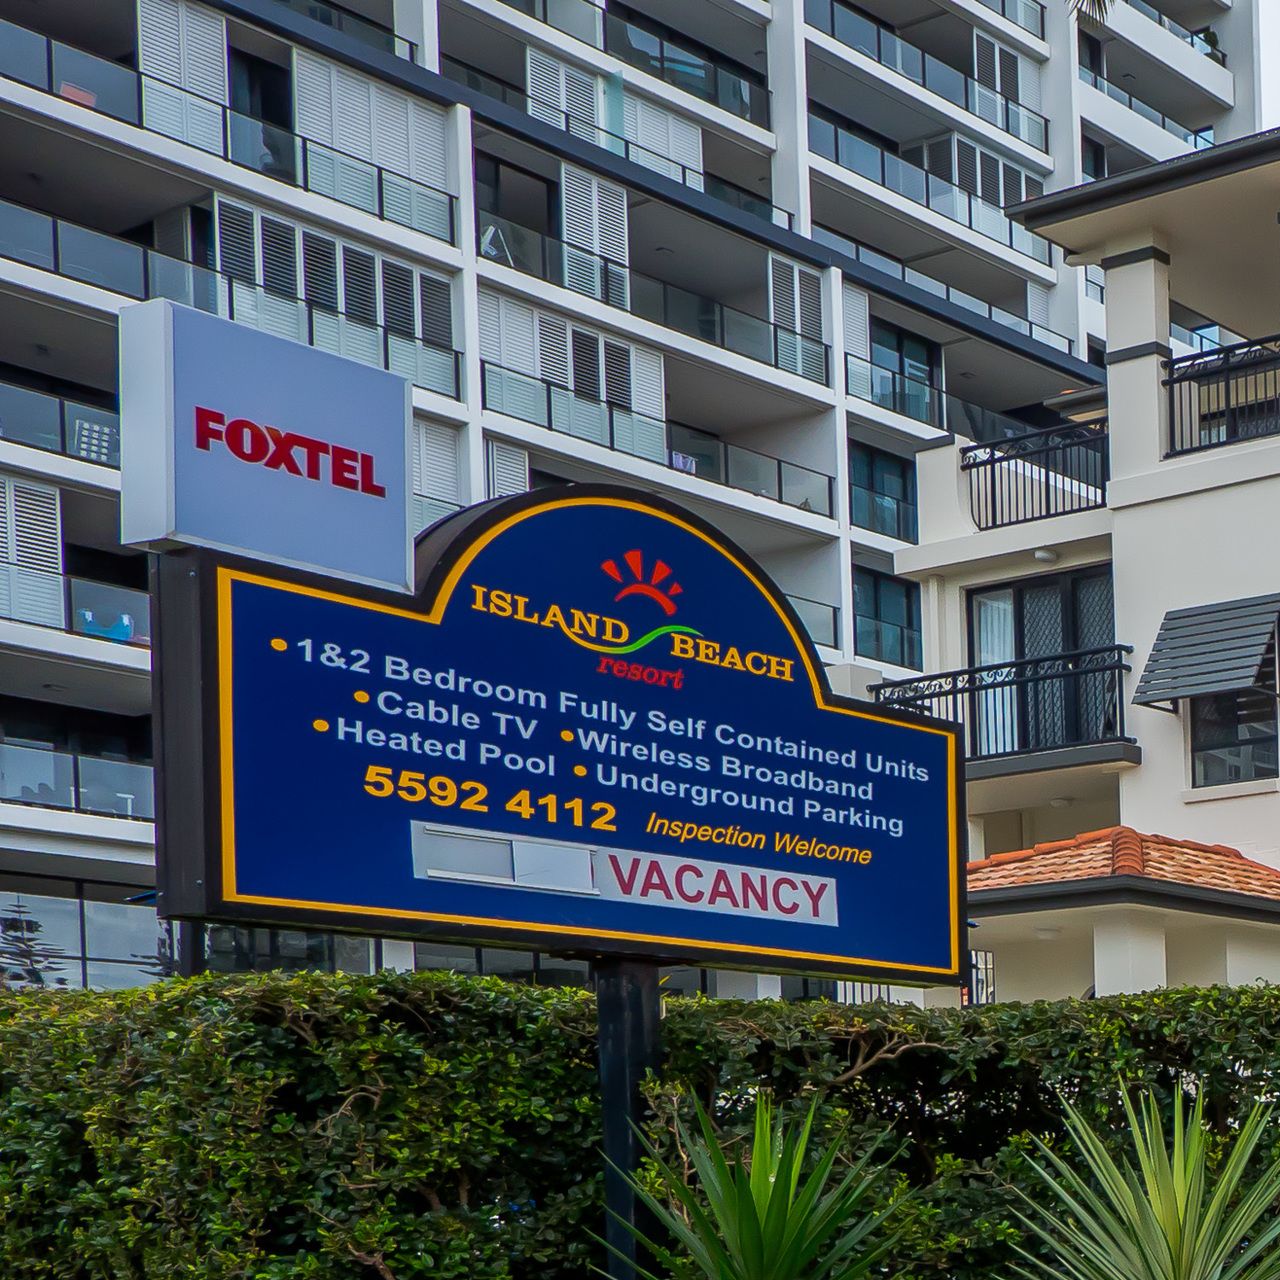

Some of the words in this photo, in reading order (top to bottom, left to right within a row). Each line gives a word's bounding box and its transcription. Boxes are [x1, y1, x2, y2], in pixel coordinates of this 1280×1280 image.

[195, 405, 387, 499] FOXTEL
[471, 584, 630, 645] ISLAND
[670, 632, 795, 682] BEACH
[596, 655, 684, 690] resort
[297, 638, 371, 675] 1&2
[385, 655, 547, 710] Bedroom
[559, 691, 637, 731] Fully
[647, 710, 706, 740] Self
[715, 724, 857, 769] Contained
[866, 752, 930, 782] Units
[377, 691, 481, 730] Cable
[492, 711, 538, 740] TV
[577, 728, 711, 772] Wireless
[721, 755, 874, 801] Broadband
[337, 717, 466, 762] Heated
[479, 742, 555, 777] Pool
[597, 763, 795, 816] Underground
[804, 799, 904, 838] Parking
[363, 764, 489, 813] 5592
[505, 789, 617, 832] 4112
[645, 812, 766, 850] Inspection
[774, 831, 873, 865] Welcome
[608, 853, 828, 918] VACANCY
